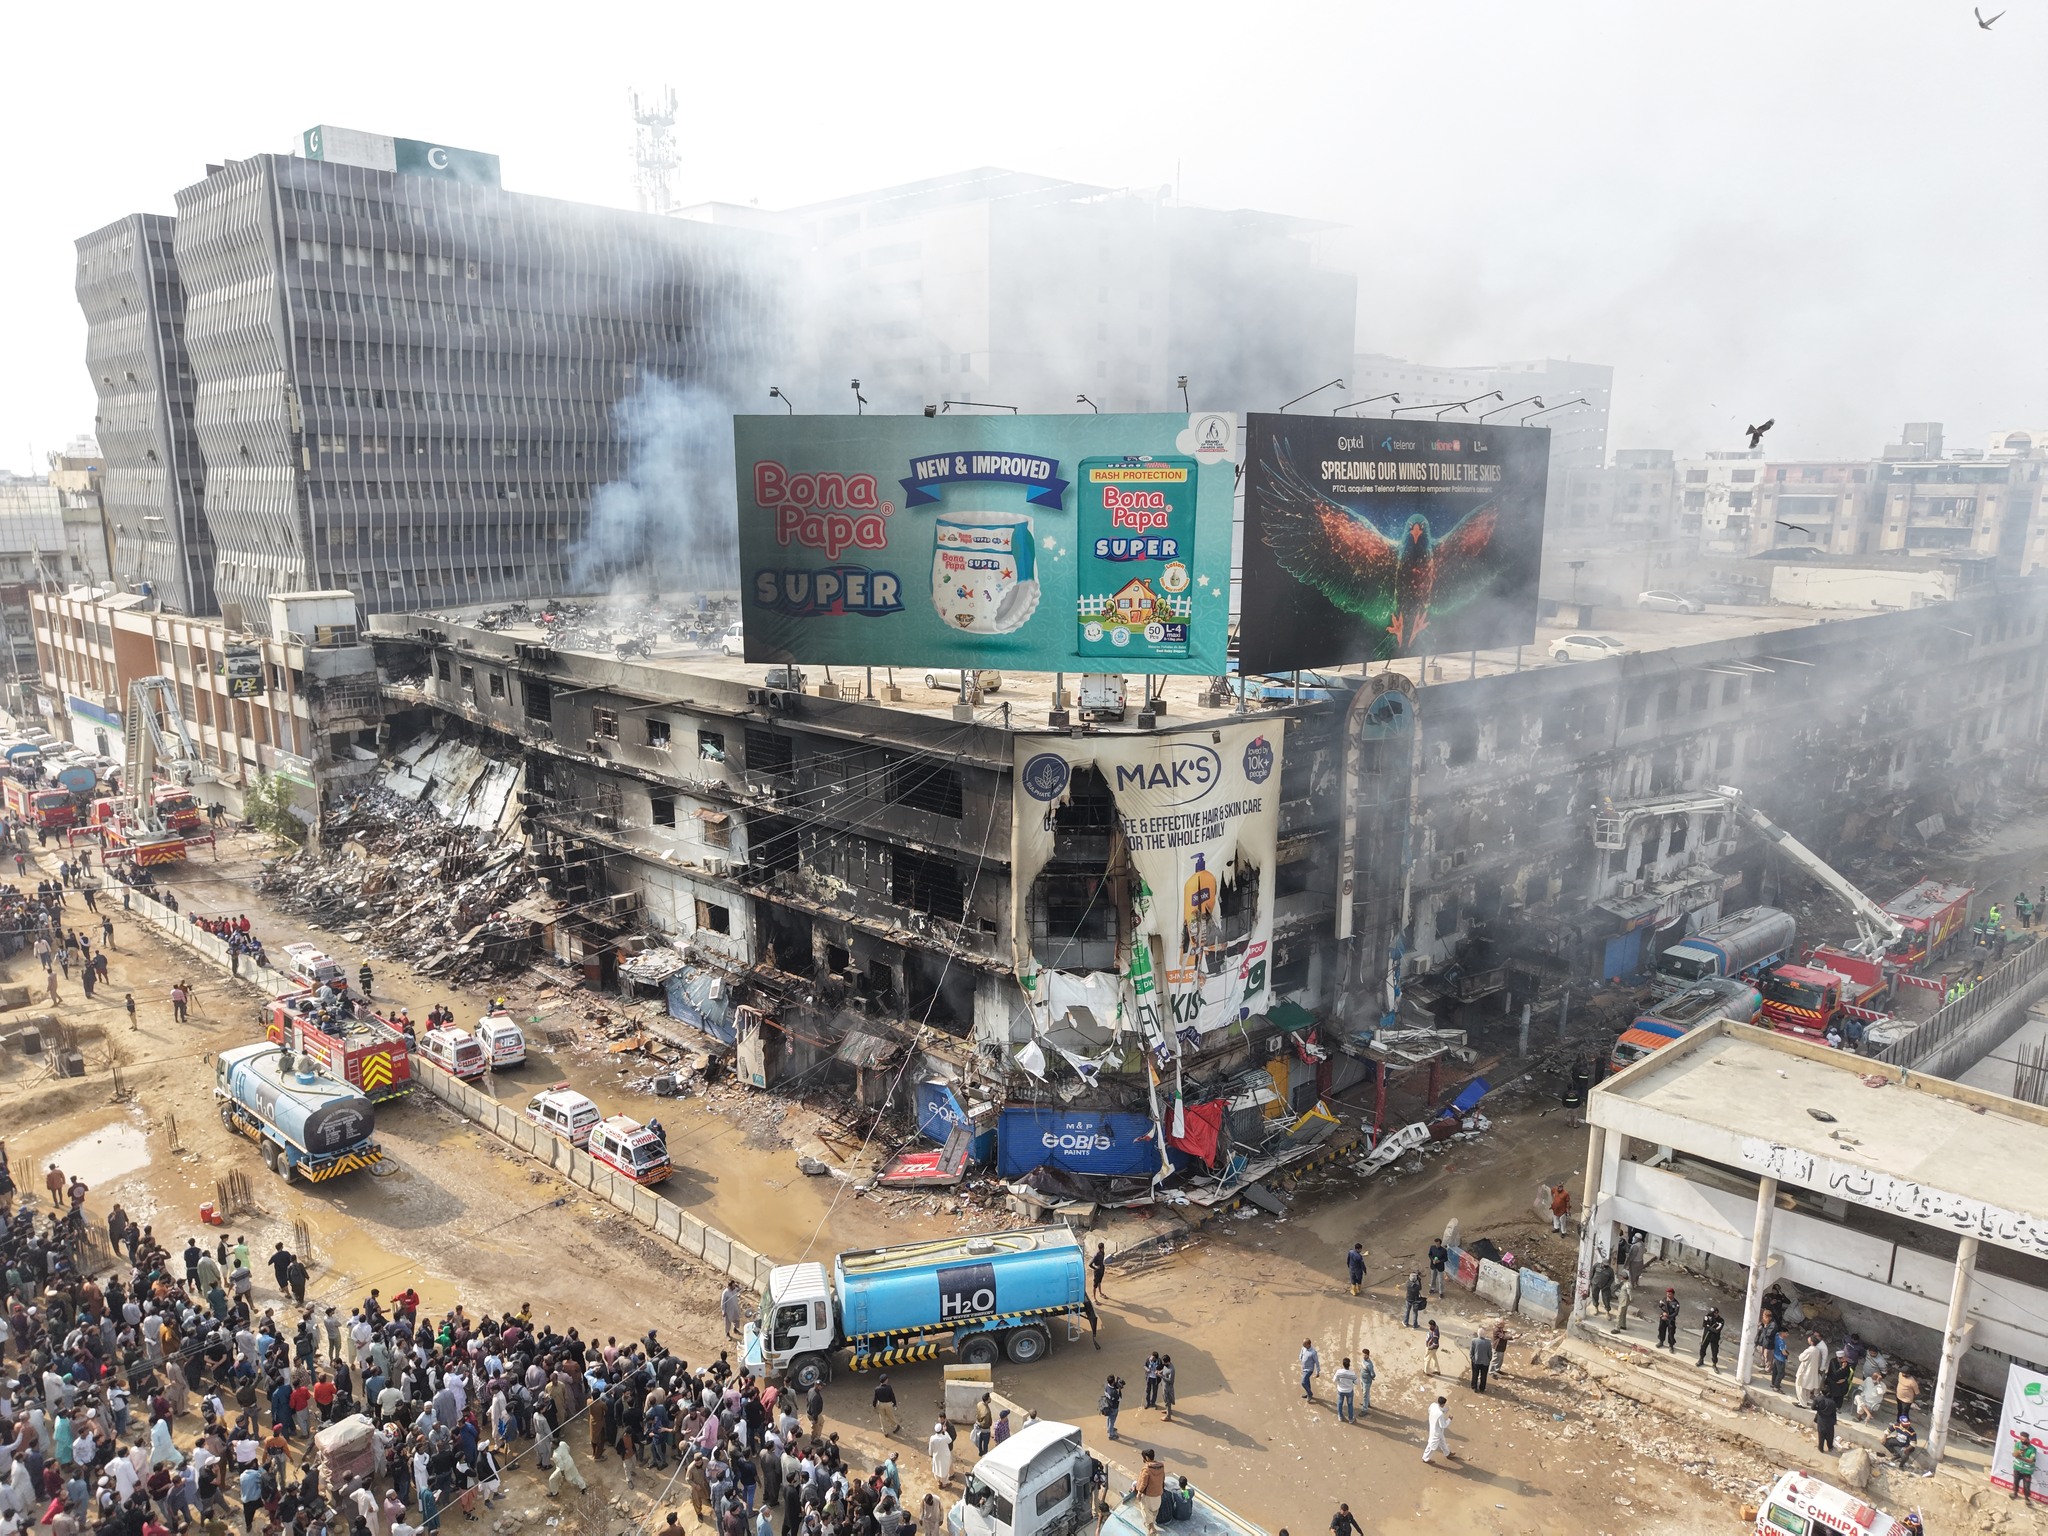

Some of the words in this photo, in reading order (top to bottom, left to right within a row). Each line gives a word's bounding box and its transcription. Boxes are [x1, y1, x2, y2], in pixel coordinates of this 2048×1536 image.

[1393, 440, 1416, 450] telenor
[1430, 439, 1452, 451] ufone
[916, 457, 950, 480] NEW
[954, 455, 968, 475] &
[972, 455, 1050, 480] IMPROVED
[1095, 471, 1120, 480] RASH
[1123, 471, 1182, 480] PROTECTION
[1321, 460, 1376, 481] SPREADING
[1377, 462, 1397, 481] OUR
[1398, 462, 1427, 481] WINGS
[1428, 462, 1440, 481] TO
[1441, 463, 1462, 482] RULE
[1463, 463, 1478, 482] THE
[1479, 464, 1501, 482] SKIES
[754, 461, 878, 509] Bona
[1332, 484, 1347, 493] PTCL
[1347, 485, 1374, 494] acquires
[1374, 485, 1396, 493] Telenor
[1396, 485, 1420, 493] Pakistan
[1420, 485, 1426, 493] to
[1426, 486, 1451, 494] empower
[1104, 486, 1165, 509] Bona
[1112, 506, 1168, 534] Papa
[775, 502, 888, 561] Papa
[1095, 539, 1177, 557] SUPER
[942, 553, 966, 563] Bona
[967, 559, 1000, 568] SUPER
[945, 561, 967, 572] Papa
[756, 571, 899, 607] SUPER
[1148, 626, 1161, 635] 50
[1165, 624, 1182, 633] L-4
[234, 677, 257, 692] A2Z
[1248, 746, 1262, 755] loved
[1262, 745, 1270, 756] by
[1247, 755, 1270, 770] 10k+
[1115, 755, 1211, 791] MAK'S
[1249, 768, 1268, 780] people
[1025, 781, 1051, 798] SULPHATE
[1122, 818, 1137, 834] FE
[1139, 818, 1148, 834] &
[1149, 812, 1201, 833] EFFECTIVE
[1202, 808, 1219, 826] HAIR
[1219, 806, 1225, 820] &
[1224, 801, 1242, 819] SKIN
[1242, 797, 1263, 815] CARE
[1145, 833, 1166, 850] THE
[1167, 827, 1200, 848] WHOLE
[1201, 821, 1226, 843] FAMILY
[457, 1056, 483, 1067] CHHIPA
[255, 1092, 275, 1121] H2O
[631, 1133, 658, 1147] CHHIPA
[941, 1288, 995, 1317] H2O
[1807, 1504, 1859, 1536] CHHIPA
